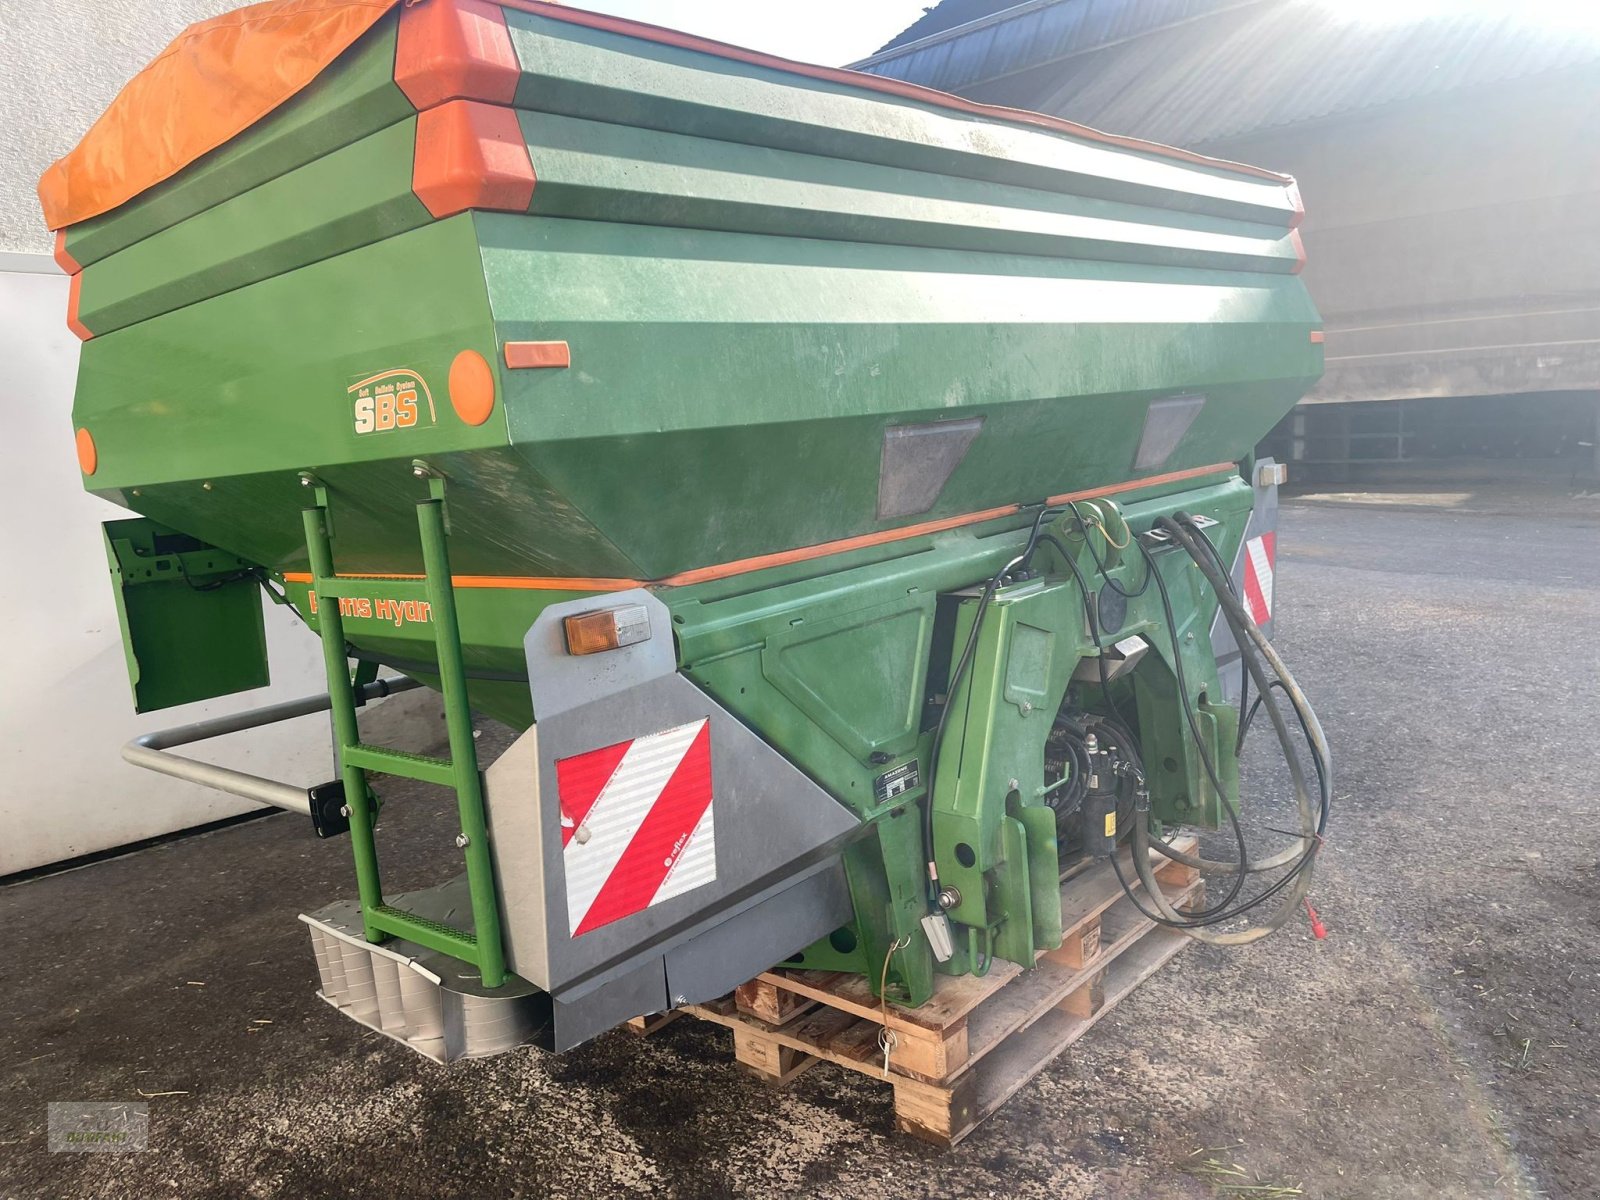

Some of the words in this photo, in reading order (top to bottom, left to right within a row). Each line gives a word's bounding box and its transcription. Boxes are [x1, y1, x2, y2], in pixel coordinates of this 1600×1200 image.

[355, 389, 418, 434] SBS
[374, 598, 434, 627] Hydr
[671, 832, 688, 857] reflex
